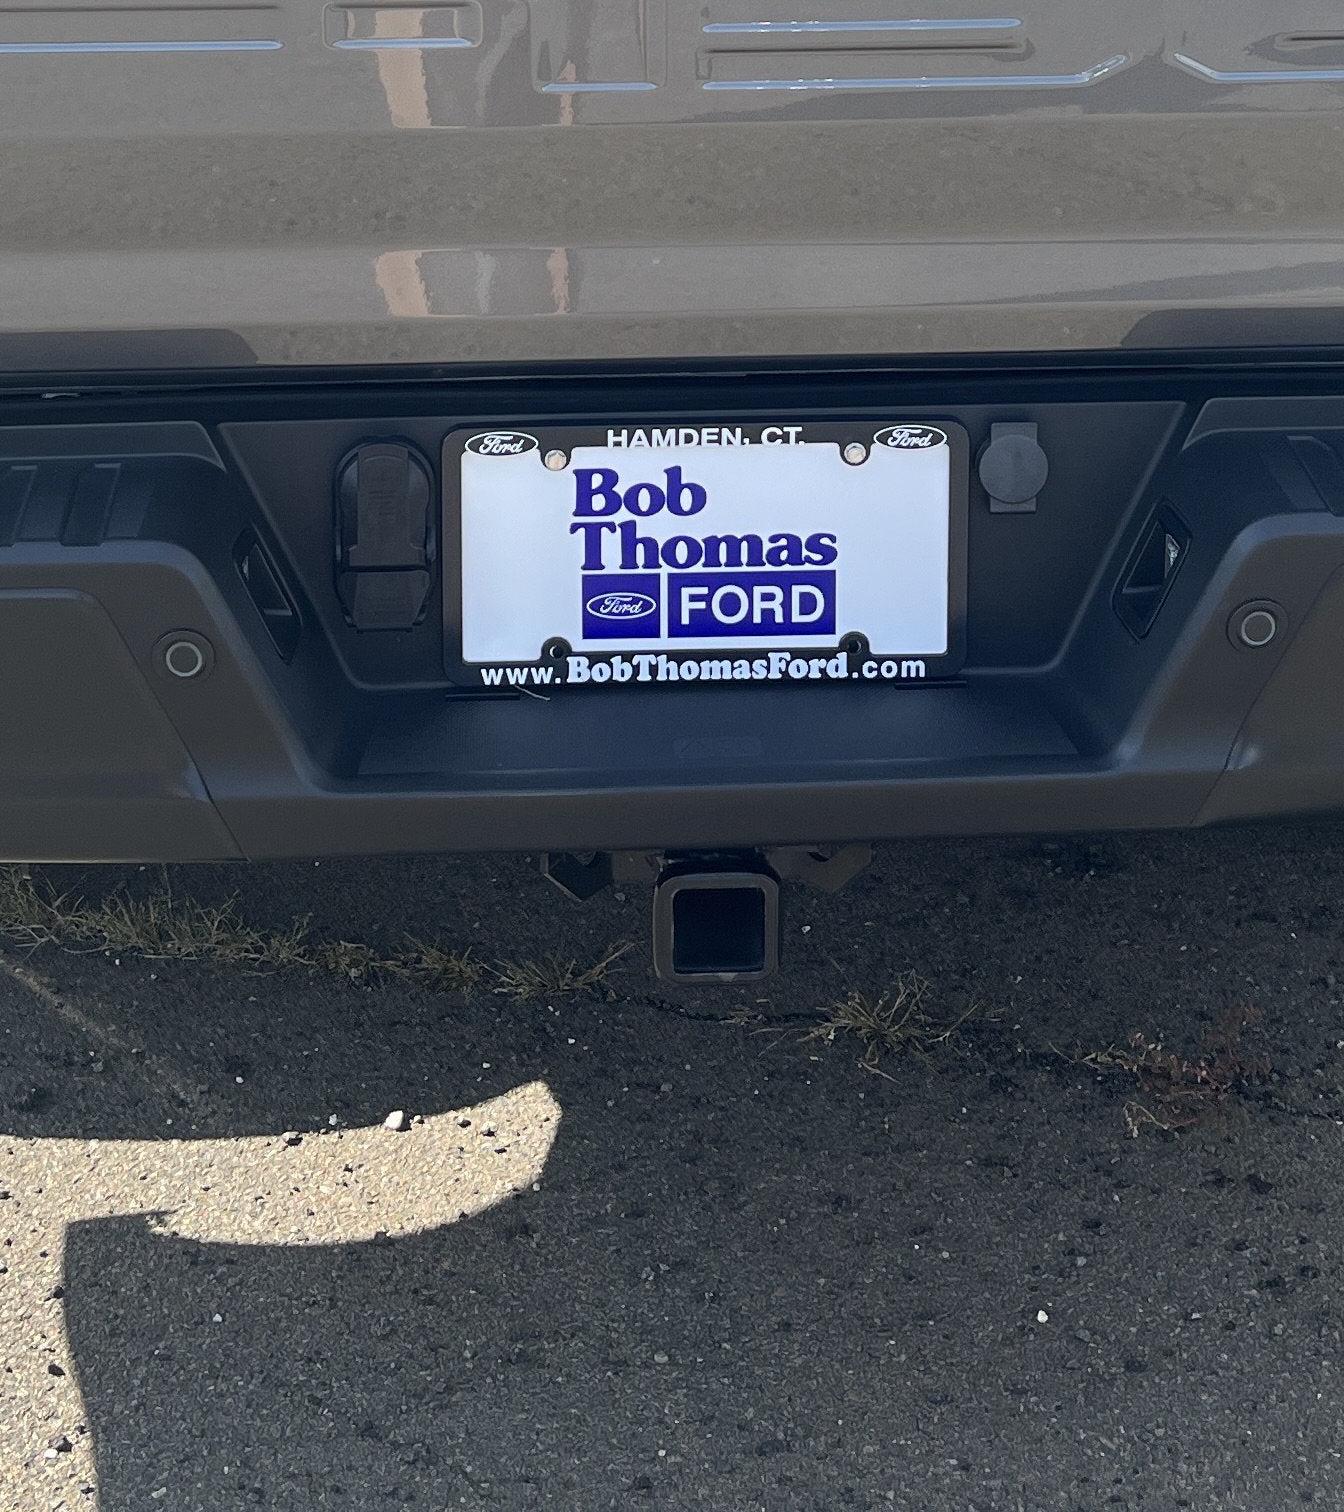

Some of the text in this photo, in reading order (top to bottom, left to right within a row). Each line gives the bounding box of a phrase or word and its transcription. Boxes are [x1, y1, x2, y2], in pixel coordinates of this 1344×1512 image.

[479, 434, 524, 455] Ford
[607, 428, 752, 449] HAMDEN,
[887, 428, 933, 448] Ford
[571, 465, 708, 518] Bob
[569, 519, 839, 572] Thomas
[599, 595, 643, 618] Ford
[679, 584, 825, 626] FORD
[480, 651, 927, 687] www.BobThomasFord.com
